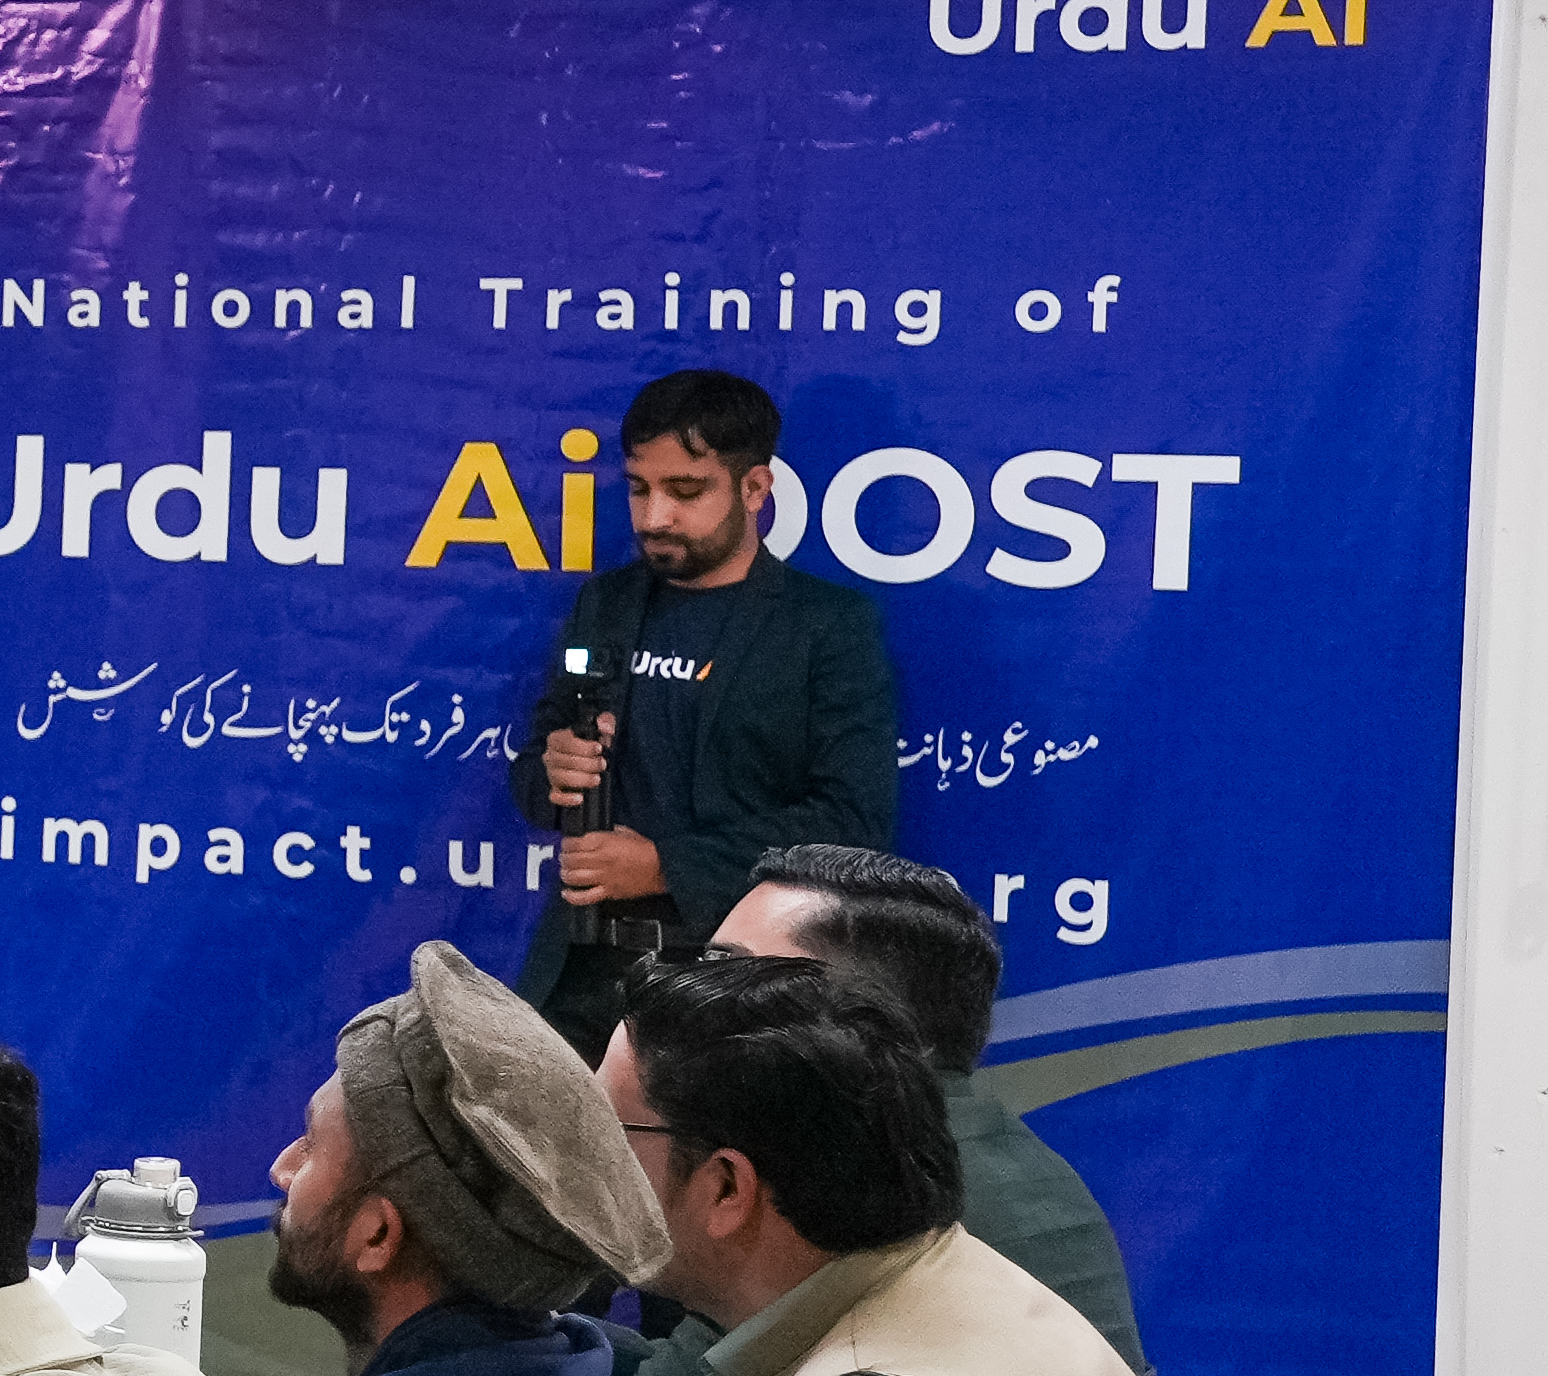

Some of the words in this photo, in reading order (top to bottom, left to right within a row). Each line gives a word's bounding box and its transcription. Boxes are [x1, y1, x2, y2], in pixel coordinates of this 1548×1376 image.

[2, 272, 417, 330] National
[480, 272, 942, 347] Training
[1014, 274, 1122, 334] of
[404, 428, 599, 573] Ai
[181, 667, 240, 750] کی
[341, 679, 422, 745] تک
[413, 691, 466, 761] فرد
[456, 724, 502, 762] ہر
[975, 720, 1100, 789] مصنوعی
